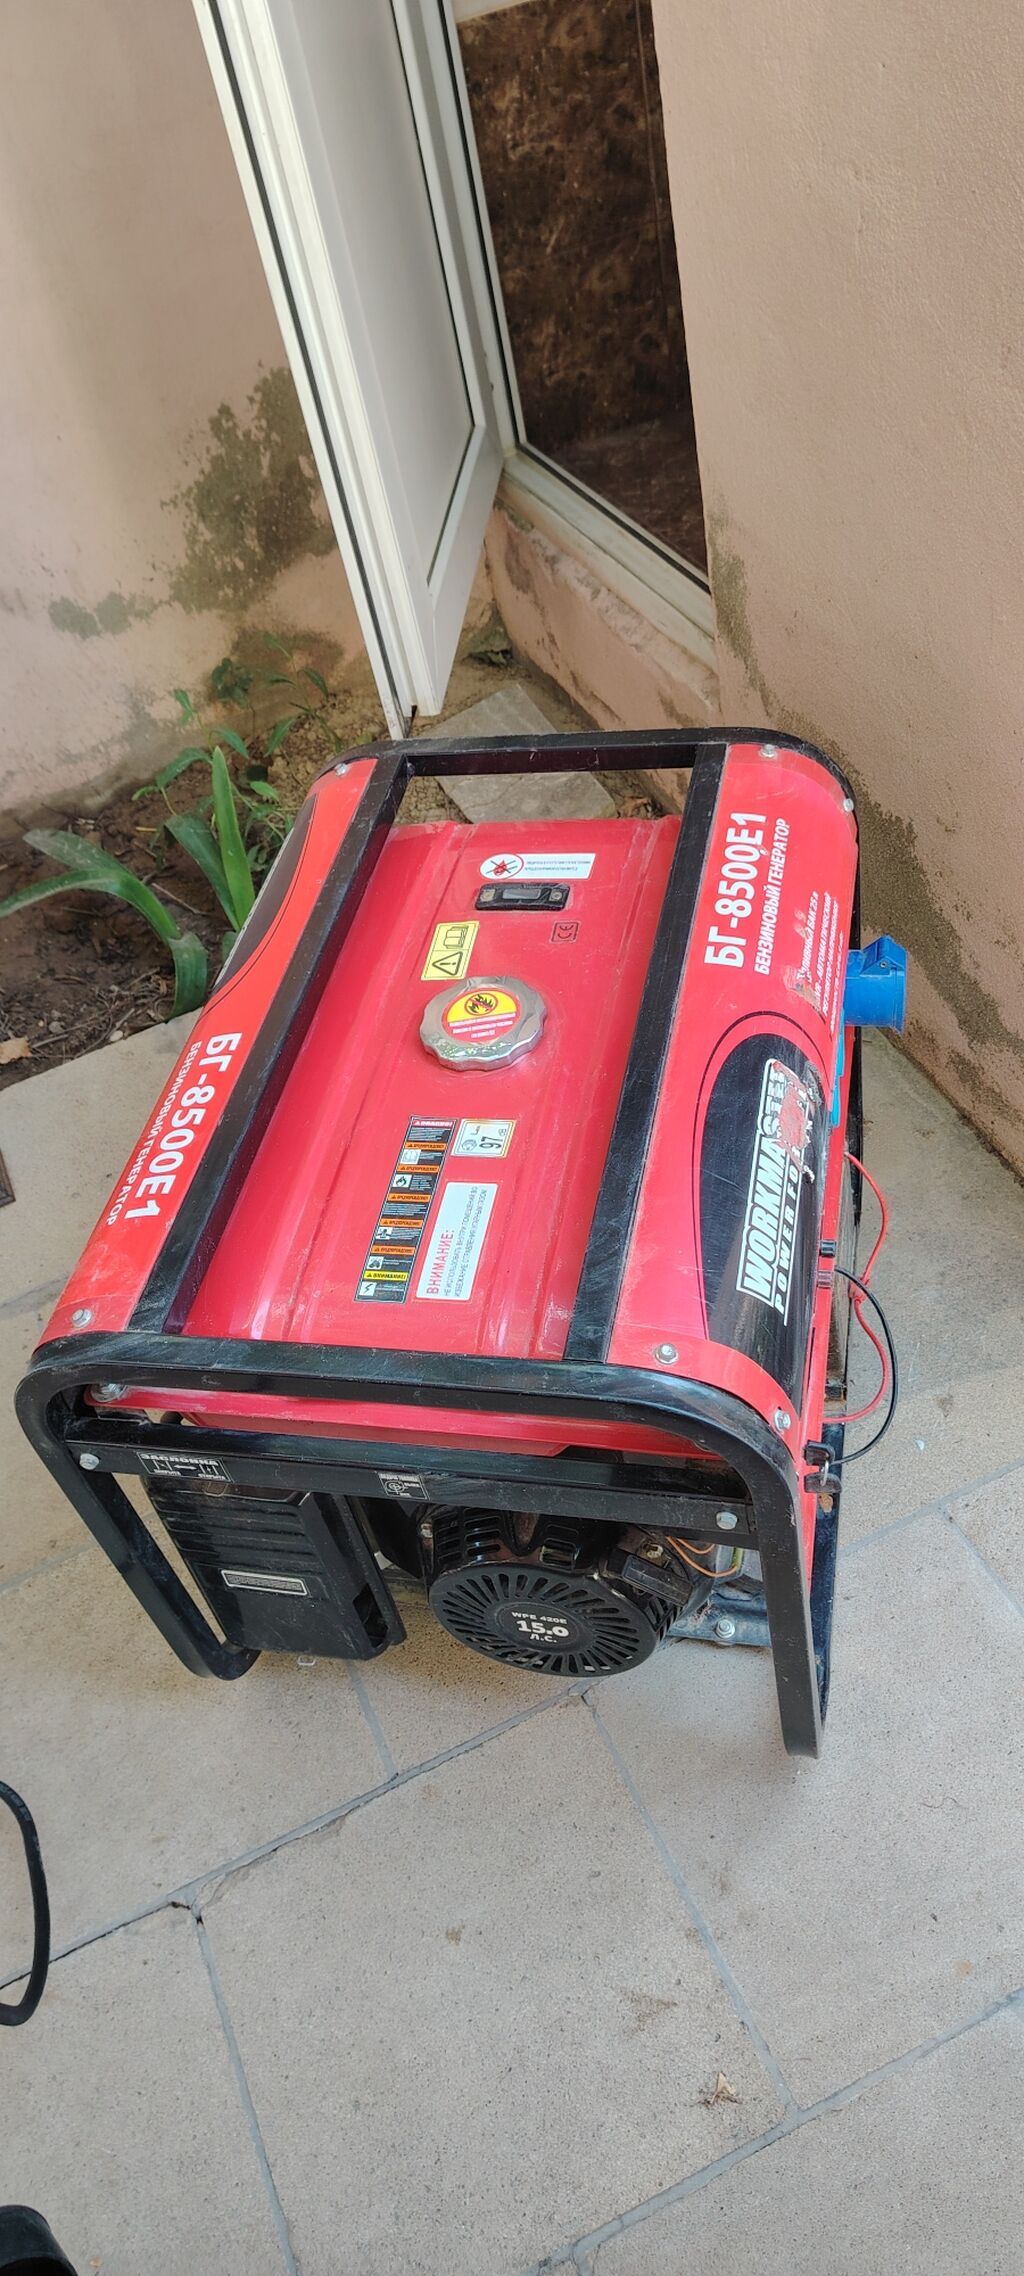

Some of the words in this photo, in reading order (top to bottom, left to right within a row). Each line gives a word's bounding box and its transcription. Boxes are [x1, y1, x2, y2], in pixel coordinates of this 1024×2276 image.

[704, 812, 767, 969] БГ-8500Е1
[754, 884, 782, 976] БЕНЗИНОВЫЙ
[768, 818, 791, 886] ГЕНЕРАТОР
[124, 1032, 242, 1220] БГ-8500Е1
[148, 1041, 202, 1139] БЕНЗИНОВЫЙ
[107, 1138, 153, 1226] ГЕНЕРАТОР
[479, 1135, 503, 1149] 97
[426, 1230, 455, 1295] ВНИМАНИЕ:
[774, 1210, 795, 1315] POWER
[512, 1611, 537, 1620] WPE
[540, 1616, 567, 1624] 420E
[516, 1620, 569, 1637] 15.0
